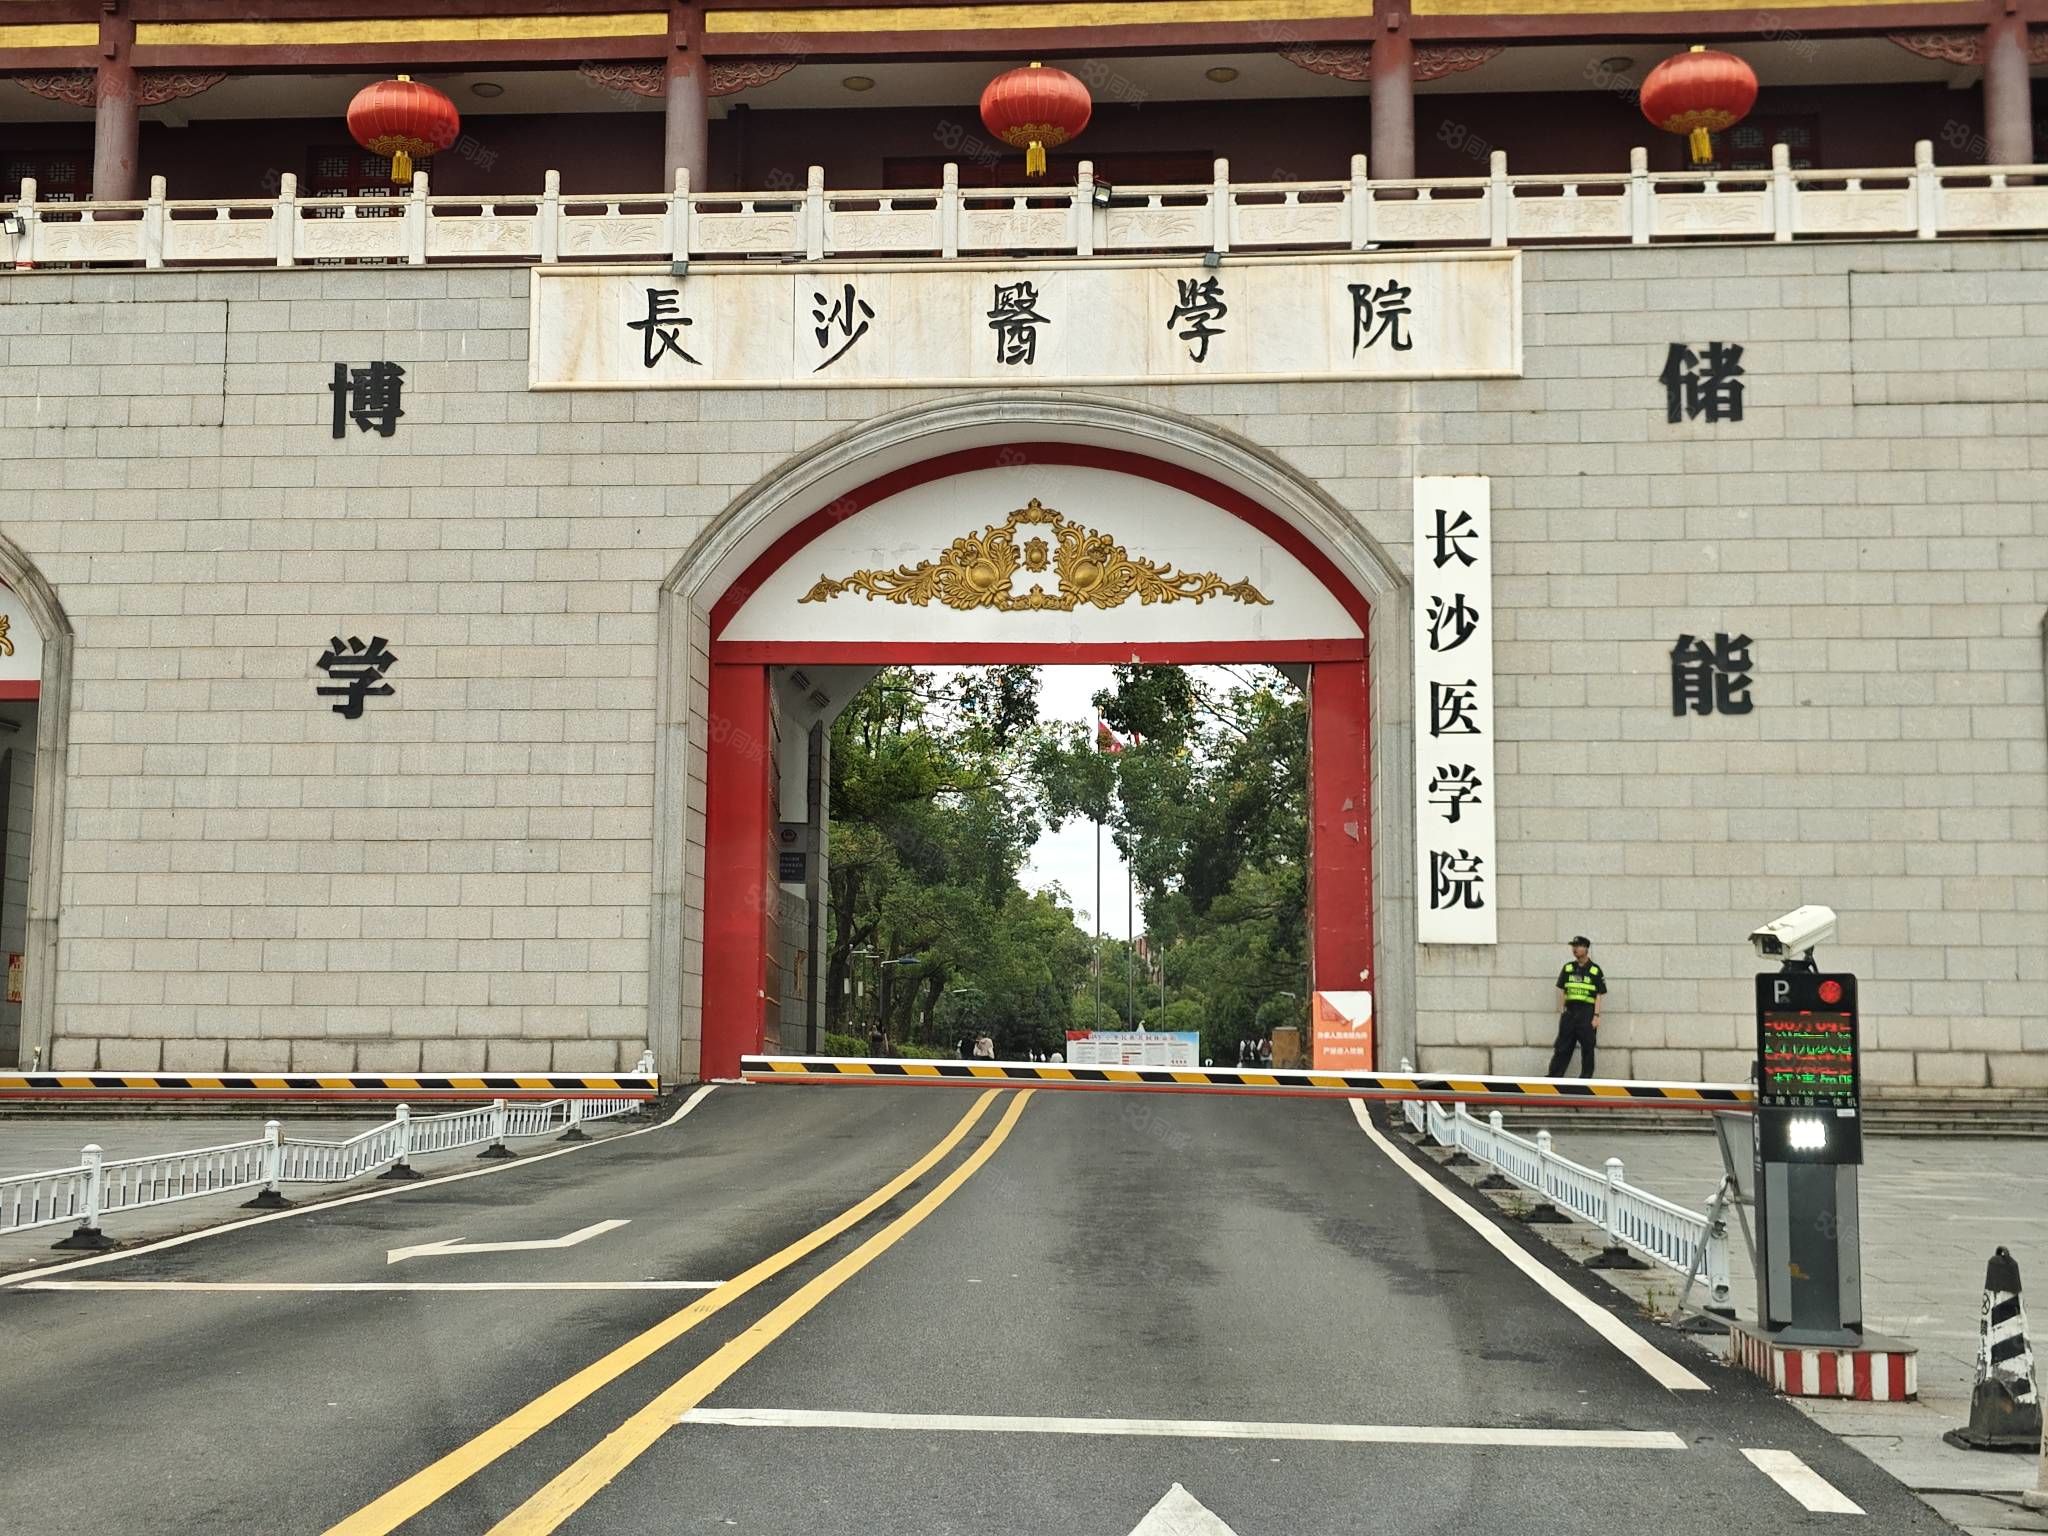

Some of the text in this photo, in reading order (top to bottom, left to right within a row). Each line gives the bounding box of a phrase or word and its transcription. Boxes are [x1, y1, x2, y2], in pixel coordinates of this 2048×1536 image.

[1426, 509, 1484, 910] 长沙医学院
[1762, 1095, 1857, 1107] 车牌识别一体机
